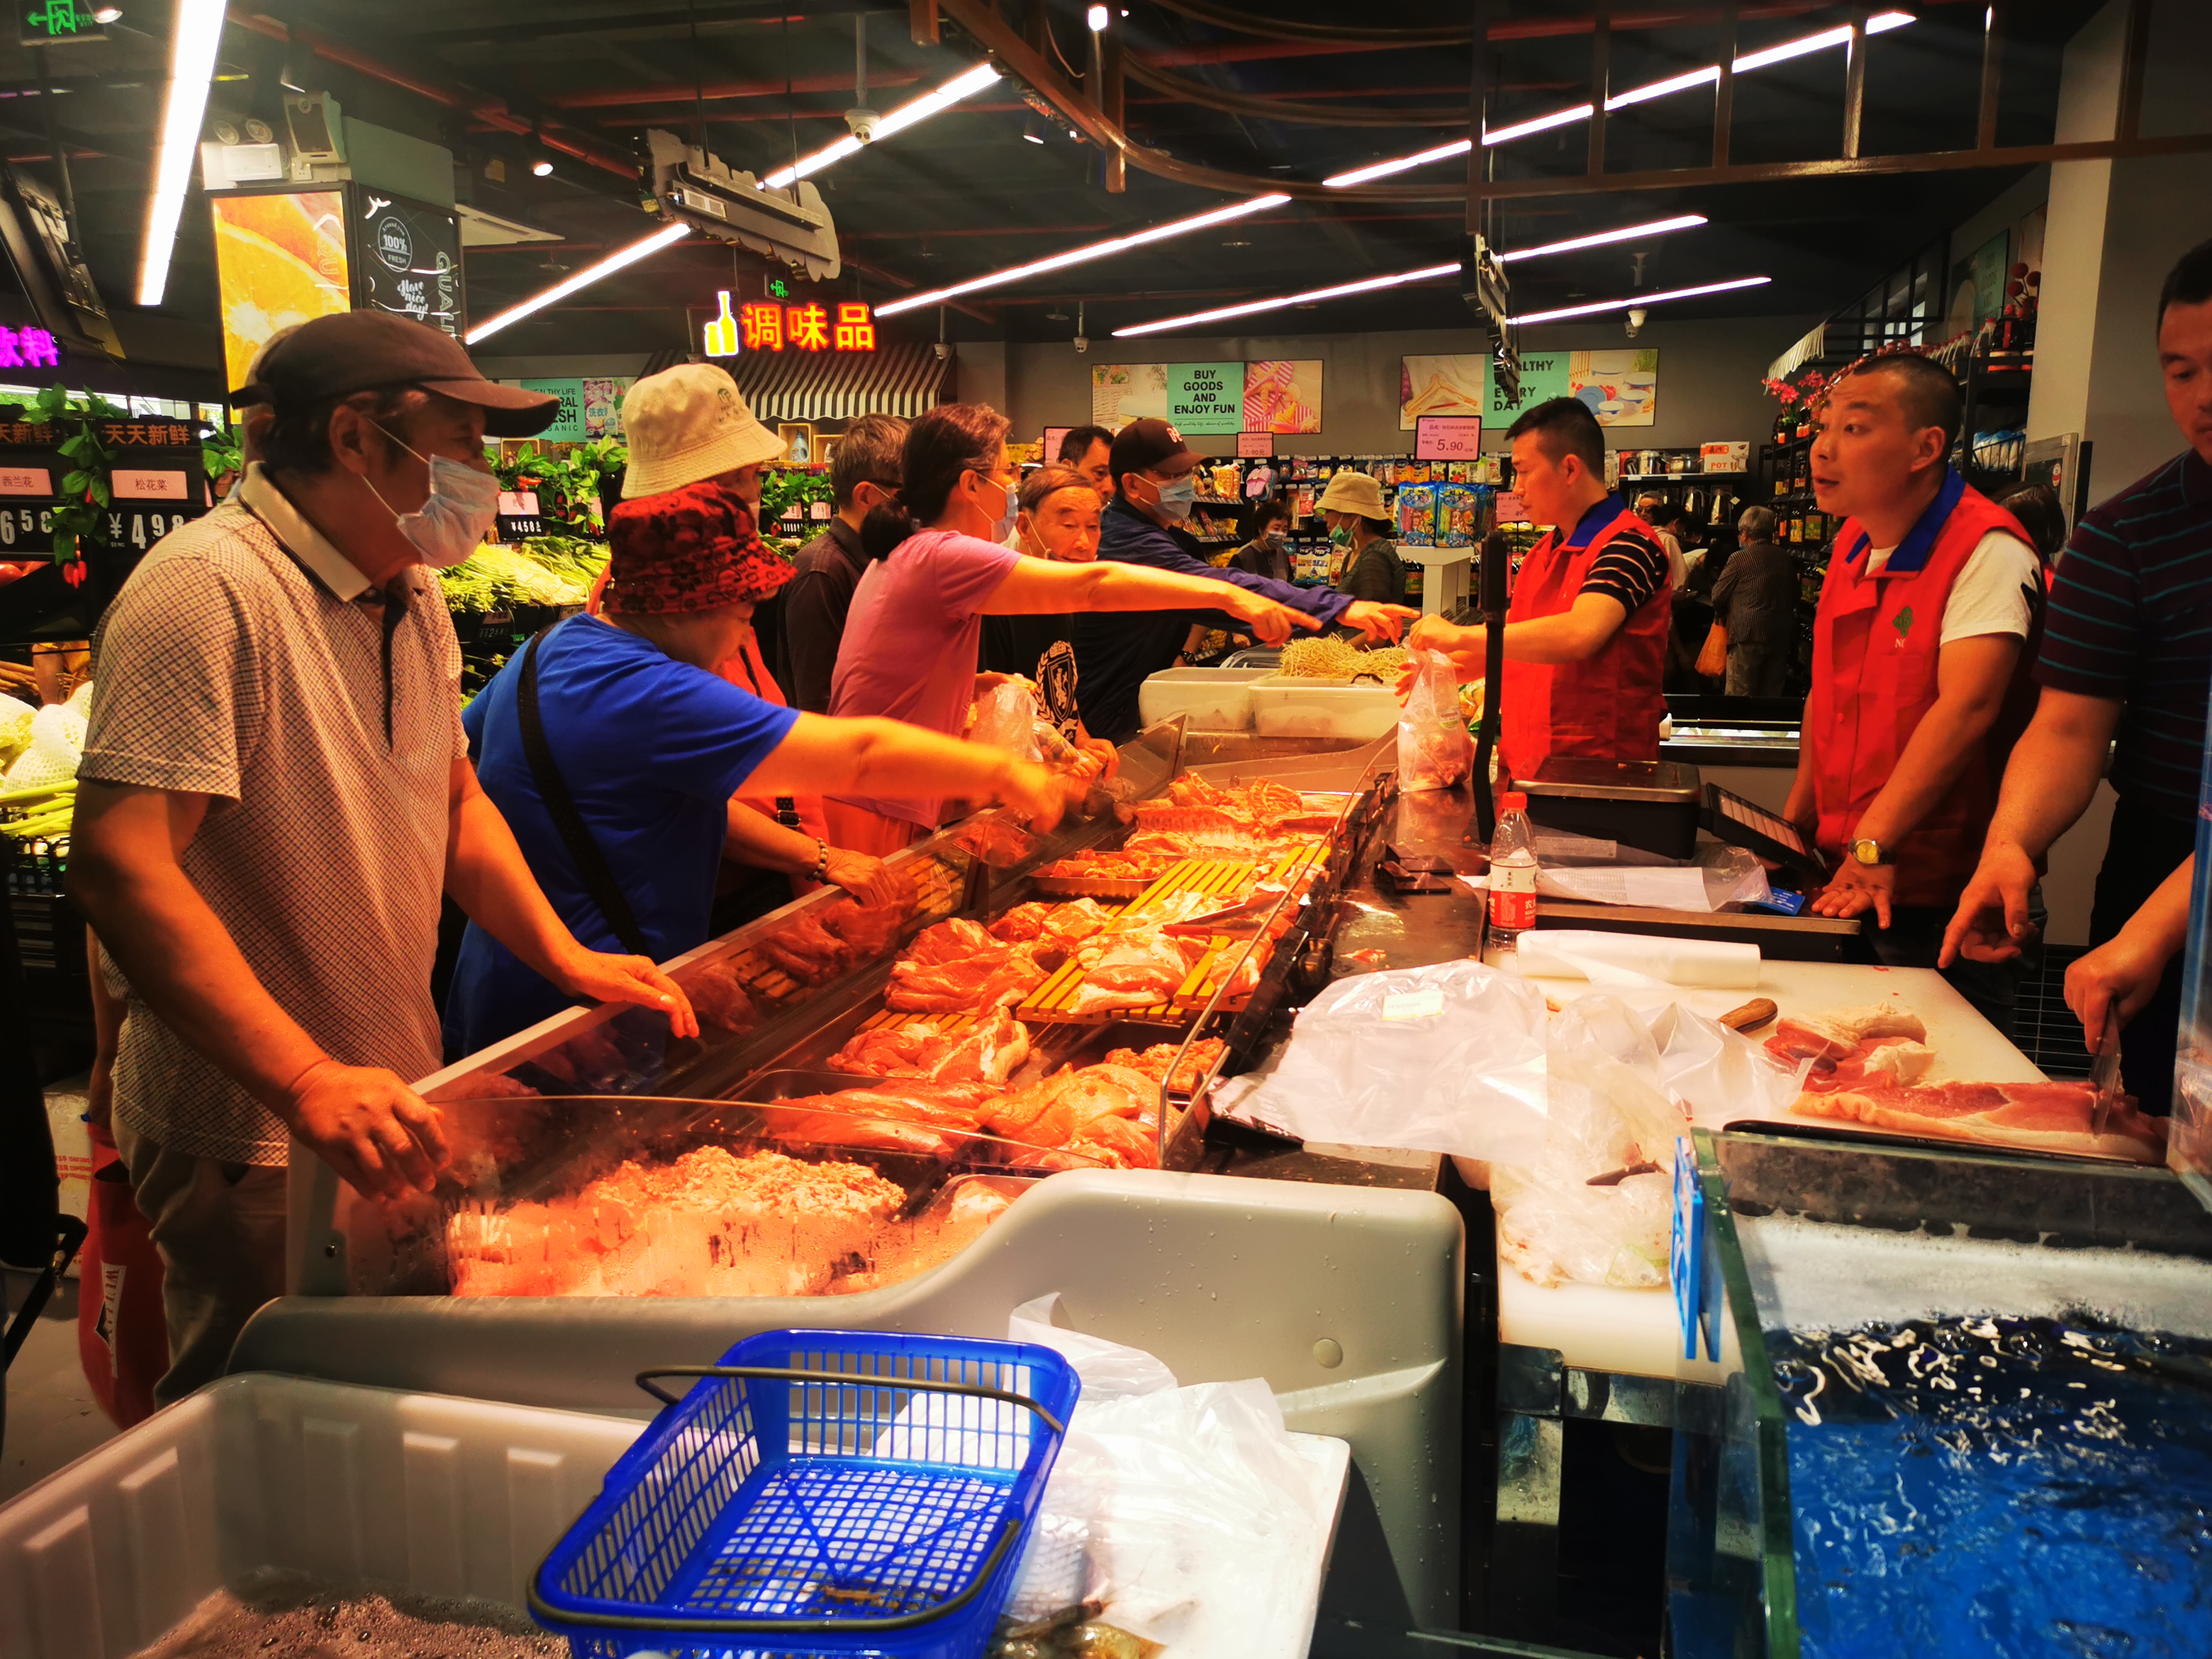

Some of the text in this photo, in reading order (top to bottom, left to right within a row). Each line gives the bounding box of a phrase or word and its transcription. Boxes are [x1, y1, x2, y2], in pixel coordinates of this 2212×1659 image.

[383, 234, 407, 251] 100%
[387, 254, 407, 265] FRESH
[397, 279, 424, 297] Have
[436, 251, 455, 332] QUALI
[405, 292, 426, 304] nice
[740, 302, 876, 352] 调味品
[1194, 369, 1216, 380] BUY
[1183, 381, 1224, 391] GOODS
[1193, 393, 1216, 403] AND
[1494, 387, 1536, 398] ERY
[1174, 404, 1235, 414] ENJOY FUN
[1493, 400, 1523, 411] DAY
[104, 424, 190, 446] 天天新鲜
[1436, 438, 1463, 451] 5.90
[1711, 462, 1728, 471] POT
[2, 476, 34, 488] 西兰花
[135, 478, 168, 492] 松花菜
